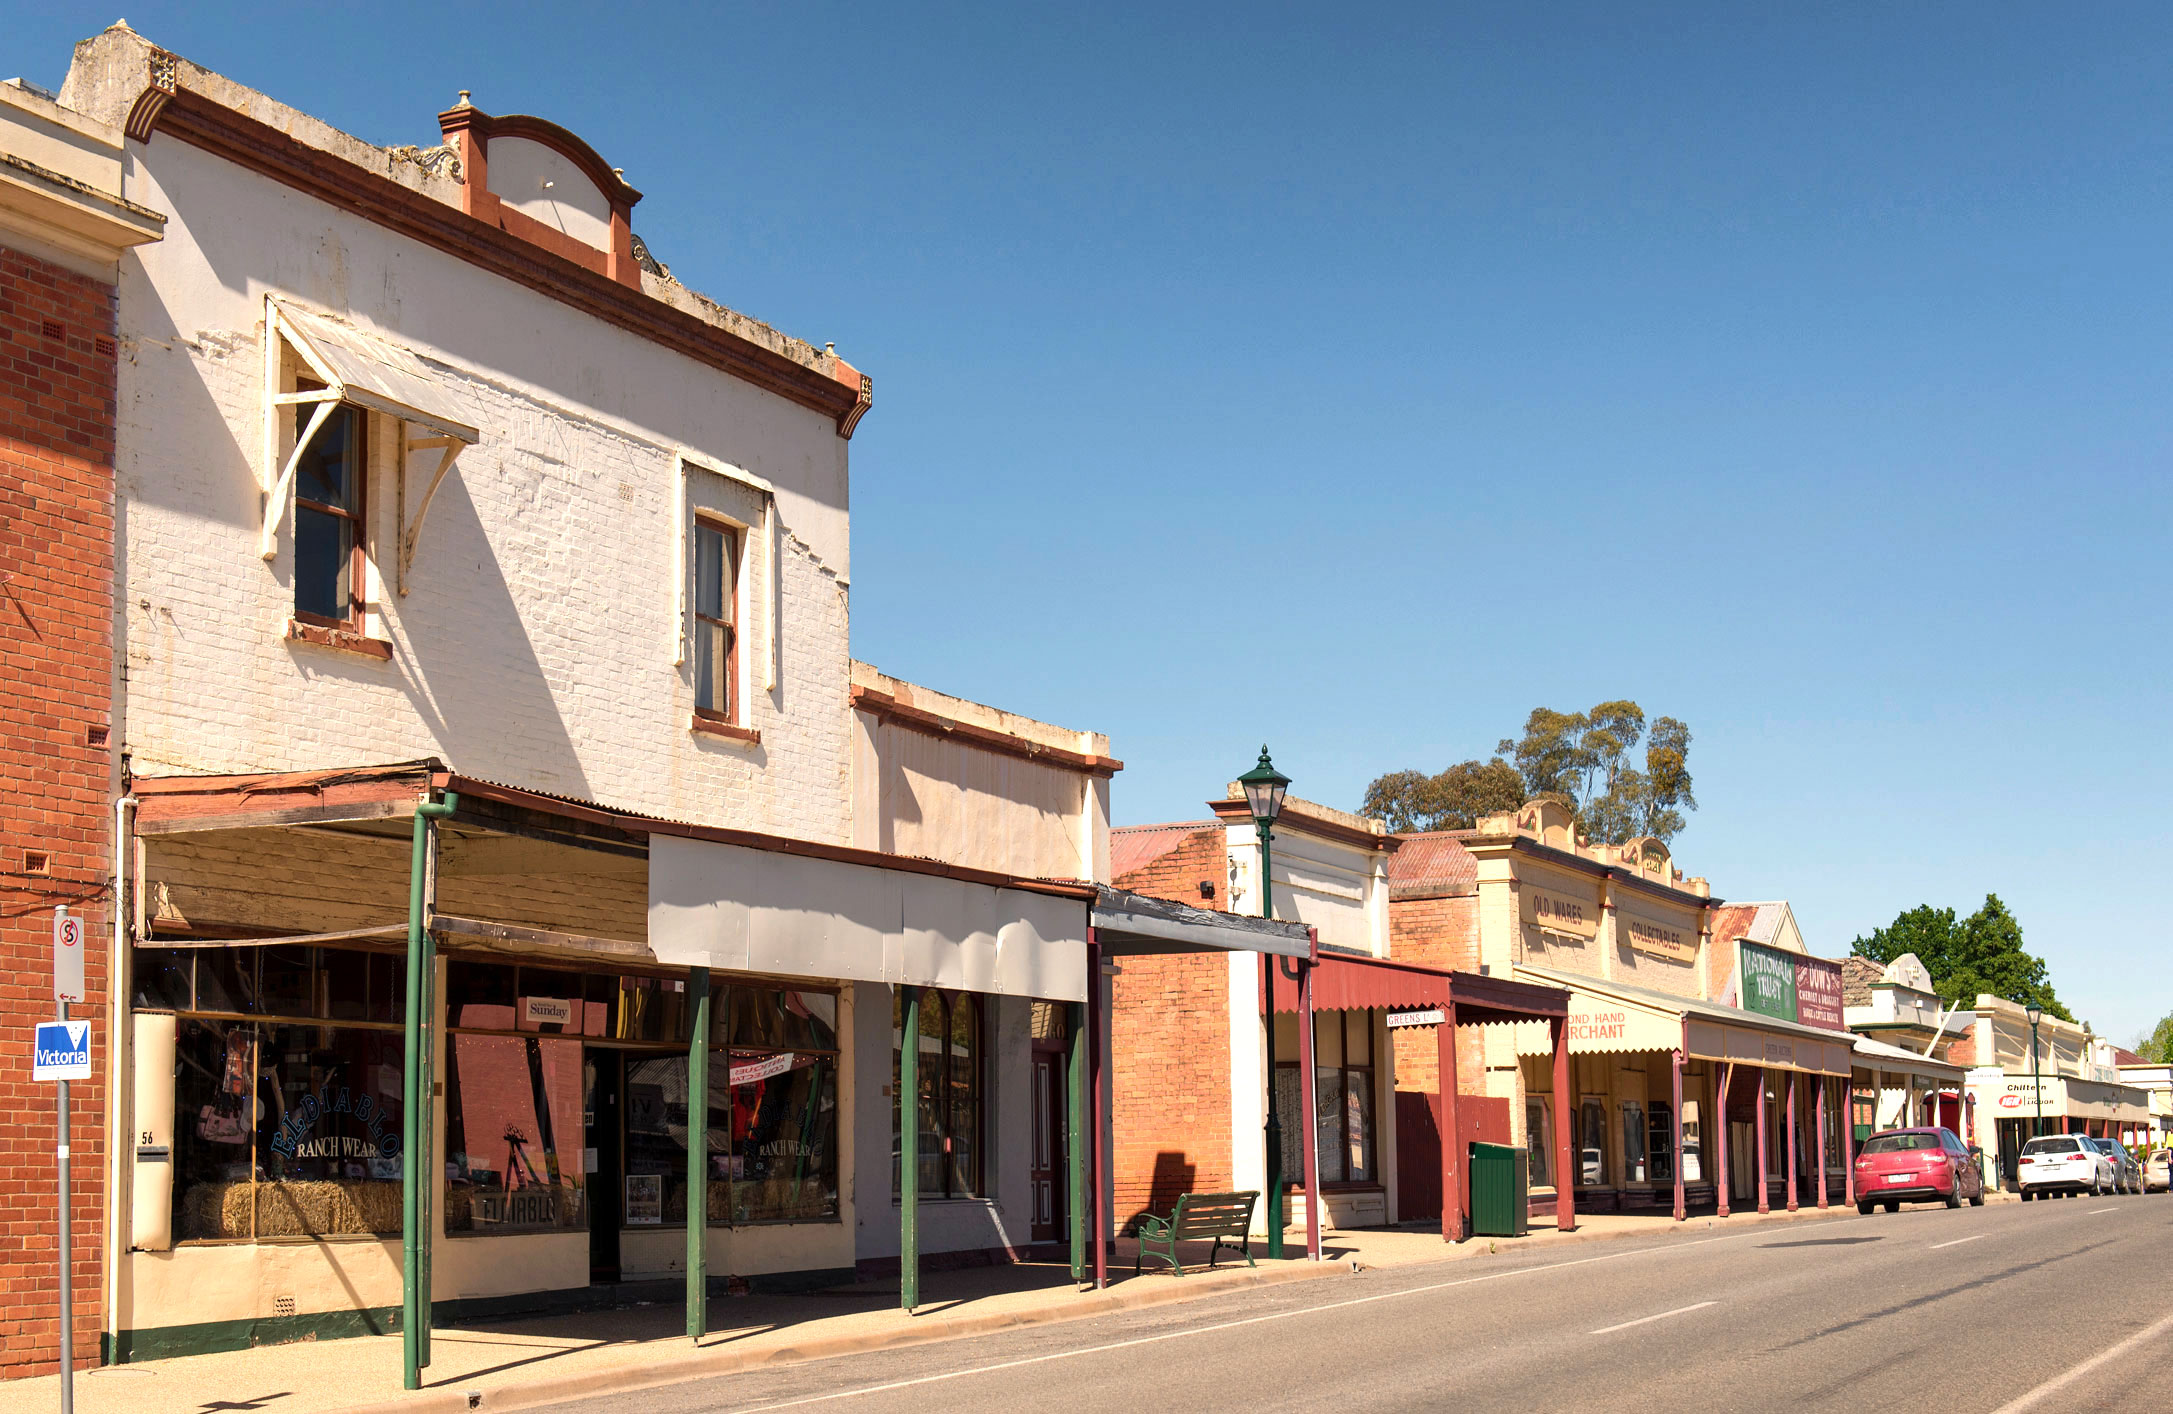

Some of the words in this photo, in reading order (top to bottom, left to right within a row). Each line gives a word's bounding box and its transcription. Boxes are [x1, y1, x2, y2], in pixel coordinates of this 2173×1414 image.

[1534, 895, 1550, 918] OLD
[1553, 899, 1583, 926] WARES
[1631, 921, 1681, 951] COLLECTABLES
[1744, 948, 1793, 985] NATIONAL
[1757, 974, 1782, 1001] TRUST
[530, 1003, 568, 1019] Sunday
[1388, 1013, 1421, 1025] GREENS
[1595, 1012, 1625, 1024] HAND
[1546, 1024, 1625, 1040] RCHANT
[38, 1049, 87, 1065] Victoria
[2001, 1096, 2021, 1106] IGA
[270, 1113, 308, 1160] EL
[300, 1086, 401, 1159] DIABLO
[142, 1131, 153, 1144] 56
[297, 1136, 340, 1158] RANCH
[341, 1136, 378, 1158] WEAR
[759, 1139, 787, 1156] RANCH
[787, 1139, 812, 1156] WEAR
